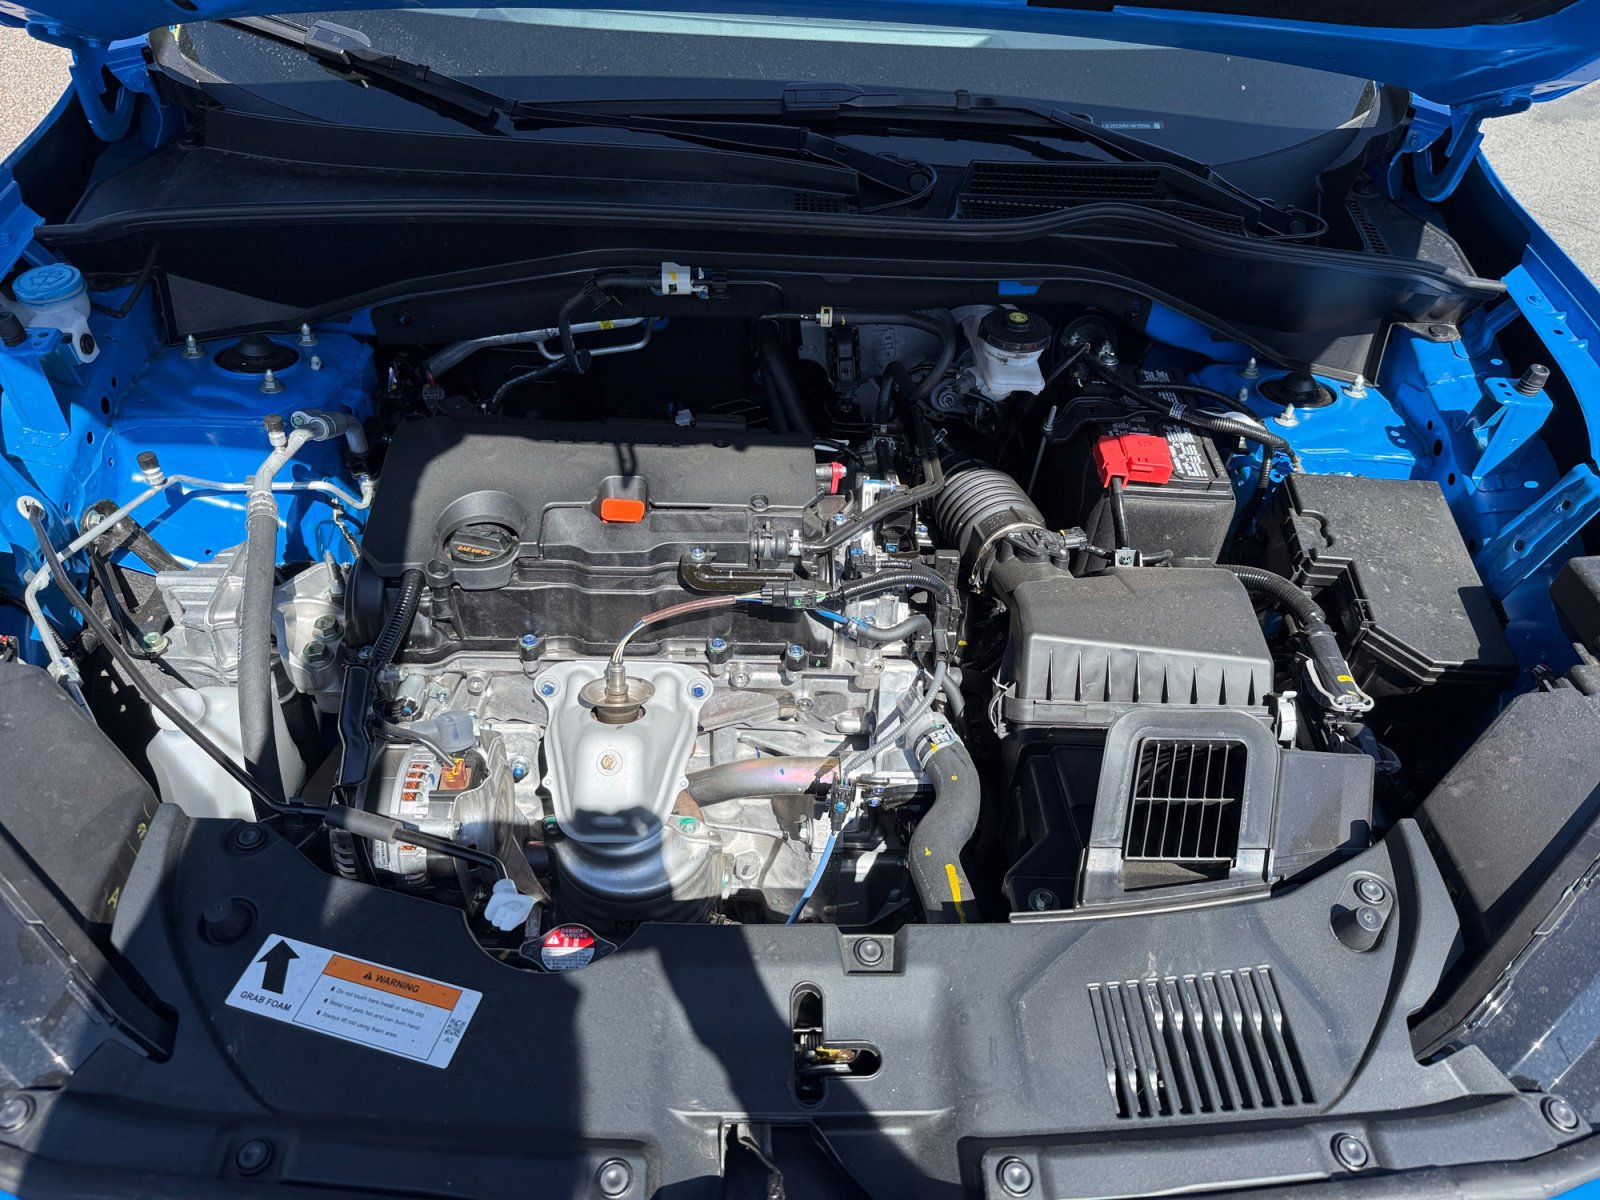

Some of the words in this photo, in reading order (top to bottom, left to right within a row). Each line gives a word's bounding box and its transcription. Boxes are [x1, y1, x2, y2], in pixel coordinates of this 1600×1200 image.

[376, 974, 419, 993] WARNING
[240, 990, 266, 1004] GRAB
[265, 998, 292, 1012] FOAM
[354, 992, 367, 1001] touch
[368, 997, 380, 1005] bare
[380, 1000, 394, 1009] metal
[322, 1012, 340, 1021] Always
[357, 1021, 371, 1031] using
[371, 1025, 385, 1034] foam
[329, 1000, 344, 1008] Metal
[374, 1012, 384, 1020] and
[395, 1018, 406, 1026] burn
